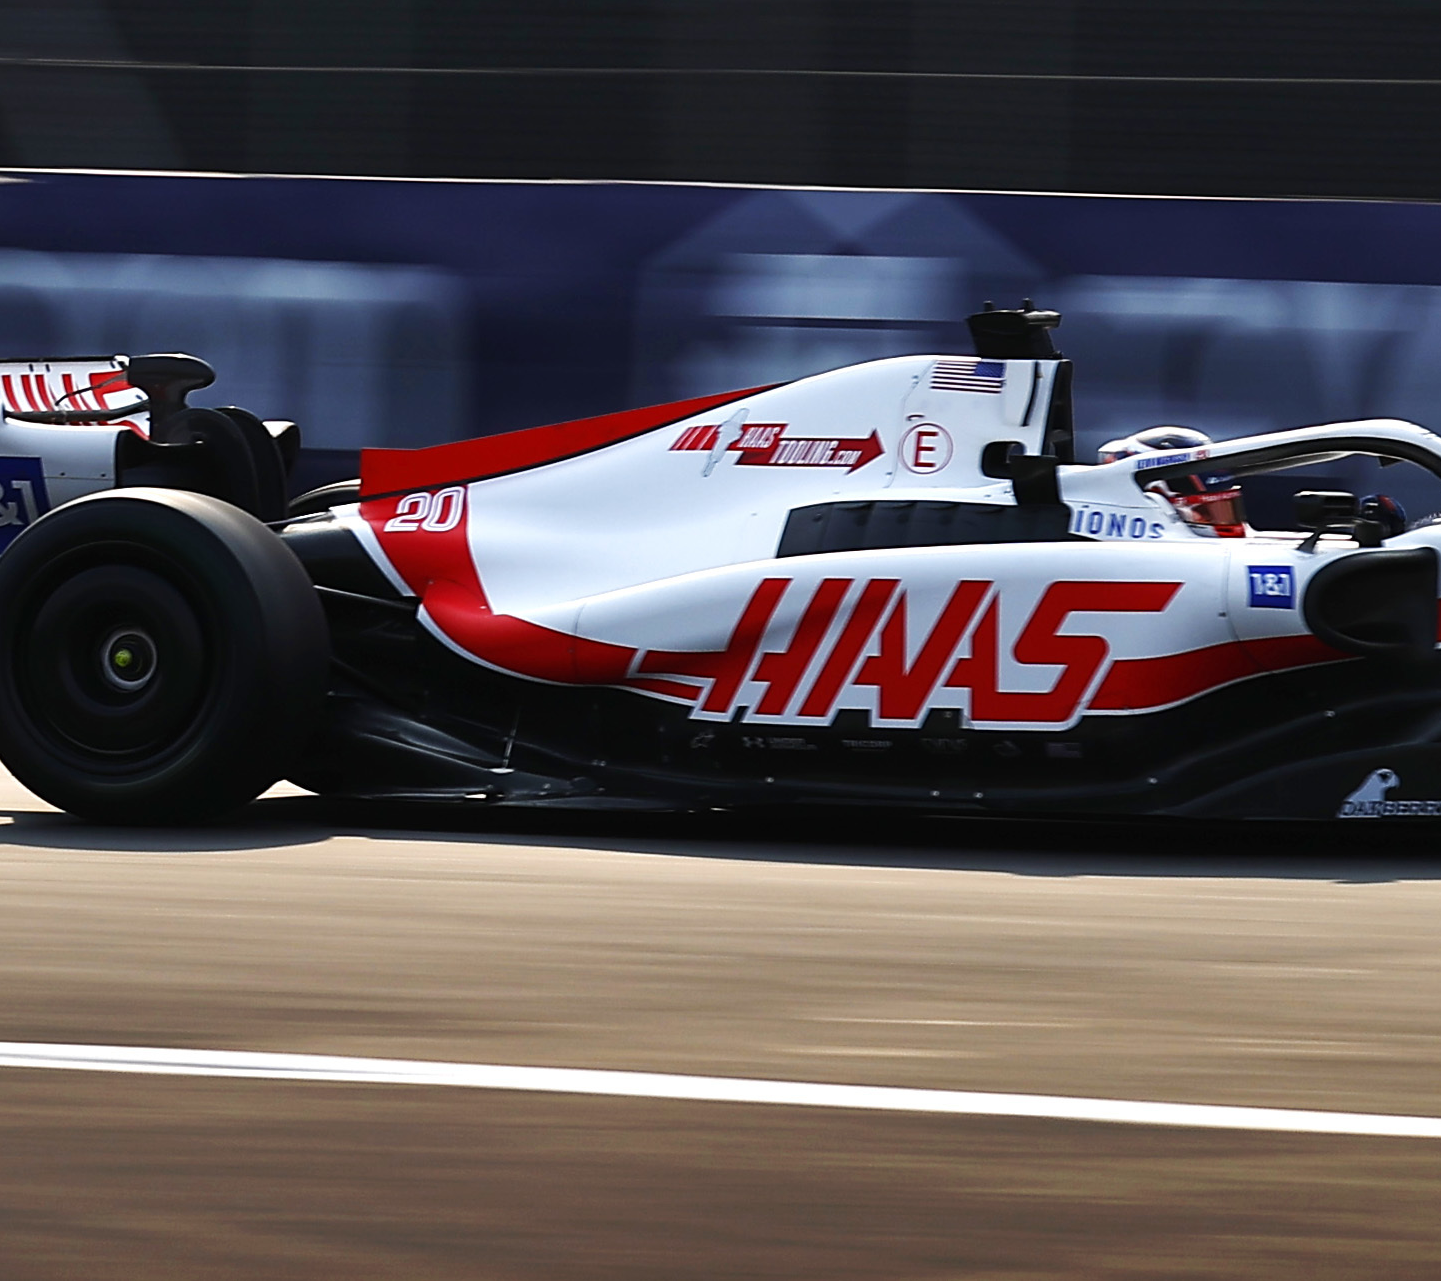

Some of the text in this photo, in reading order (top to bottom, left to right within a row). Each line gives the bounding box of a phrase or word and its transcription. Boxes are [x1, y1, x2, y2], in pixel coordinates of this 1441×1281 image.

[736, 426, 781, 449] HAAS
[914, 430, 940, 468] E
[383, 486, 465, 532] 20
[1073, 506, 1165, 540] IONOS
[1249, 573, 1292, 597] 1&1
[664, 577, 1186, 727] HAAS
